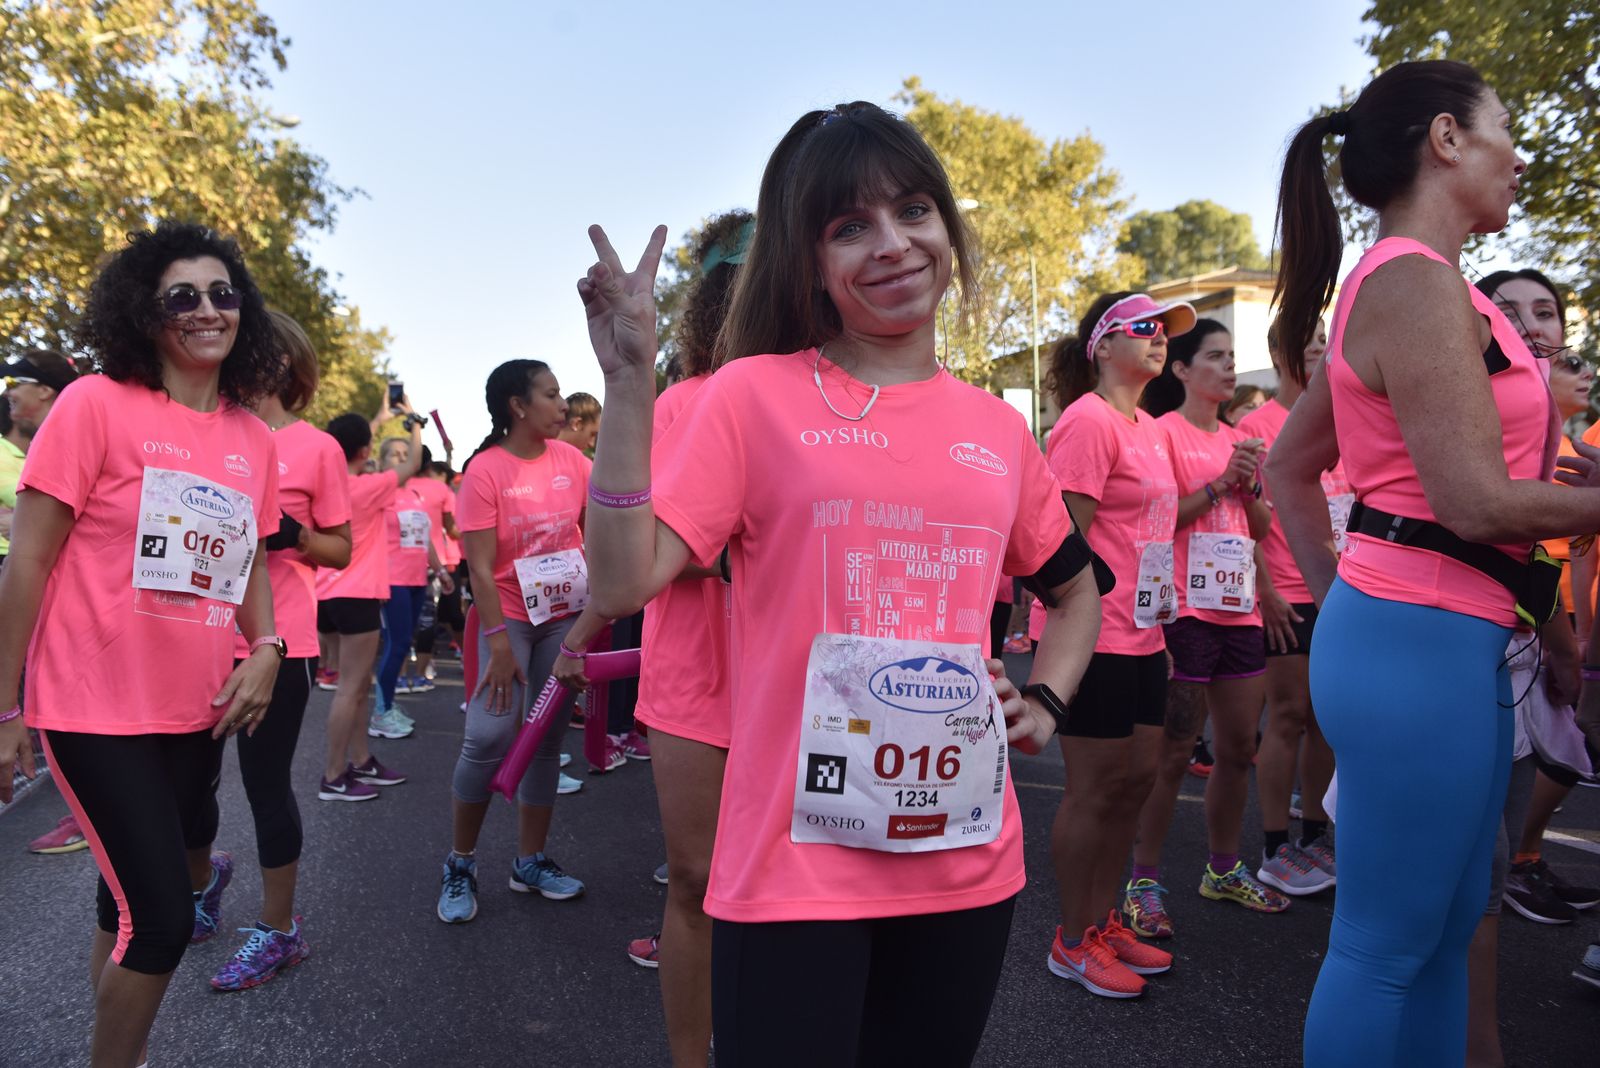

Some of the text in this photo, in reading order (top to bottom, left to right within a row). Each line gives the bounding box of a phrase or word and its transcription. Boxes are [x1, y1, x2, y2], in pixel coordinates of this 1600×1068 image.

[800, 427, 888, 449] OYSHO
[143, 441, 191, 461] OYSHO
[186, 492, 232, 516] ASTURIANA
[812, 500, 924, 532] HOY GANAN
[183, 530, 226, 559] 016
[881, 542, 929, 561] VITORIA
[141, 569, 178, 580] OYSHO
[905, 561, 957, 580] MADRID
[1215, 570, 1244, 585] 016
[543, 581, 572, 597] 016
[205, 605, 234, 628] 2019
[878, 674, 972, 699] ASTURIANA
[897, 673, 934, 683] CENTRAL
[945, 714, 980, 728] Carrera
[952, 727, 959, 736] de
[963, 726, 987, 745] Mujer
[874, 743, 962, 781] 016
[894, 790, 938, 807] 1234
[806, 814, 865, 831] OYSHO
[906, 823, 939, 832] Santander
[961, 822, 991, 835] ZURICH
